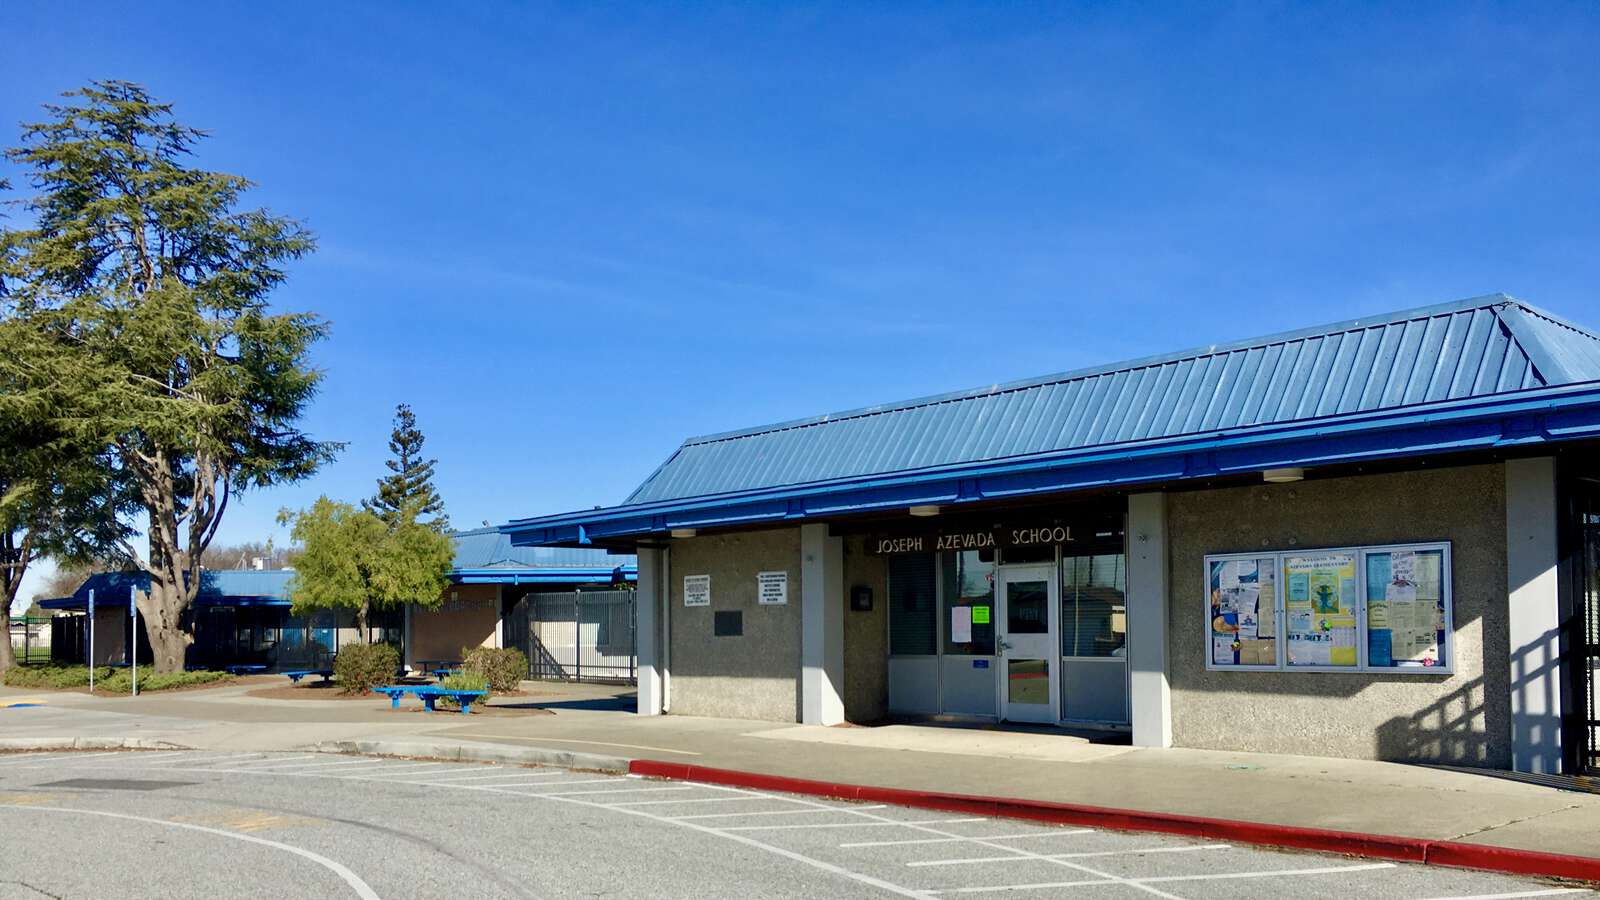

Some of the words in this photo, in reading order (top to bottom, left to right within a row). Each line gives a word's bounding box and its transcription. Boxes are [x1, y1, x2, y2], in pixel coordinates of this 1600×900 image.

[876, 537, 922, 553] JOSEPH
[936, 532, 996, 550] AZEVADA
[1012, 526, 1074, 544] SCHOOL
